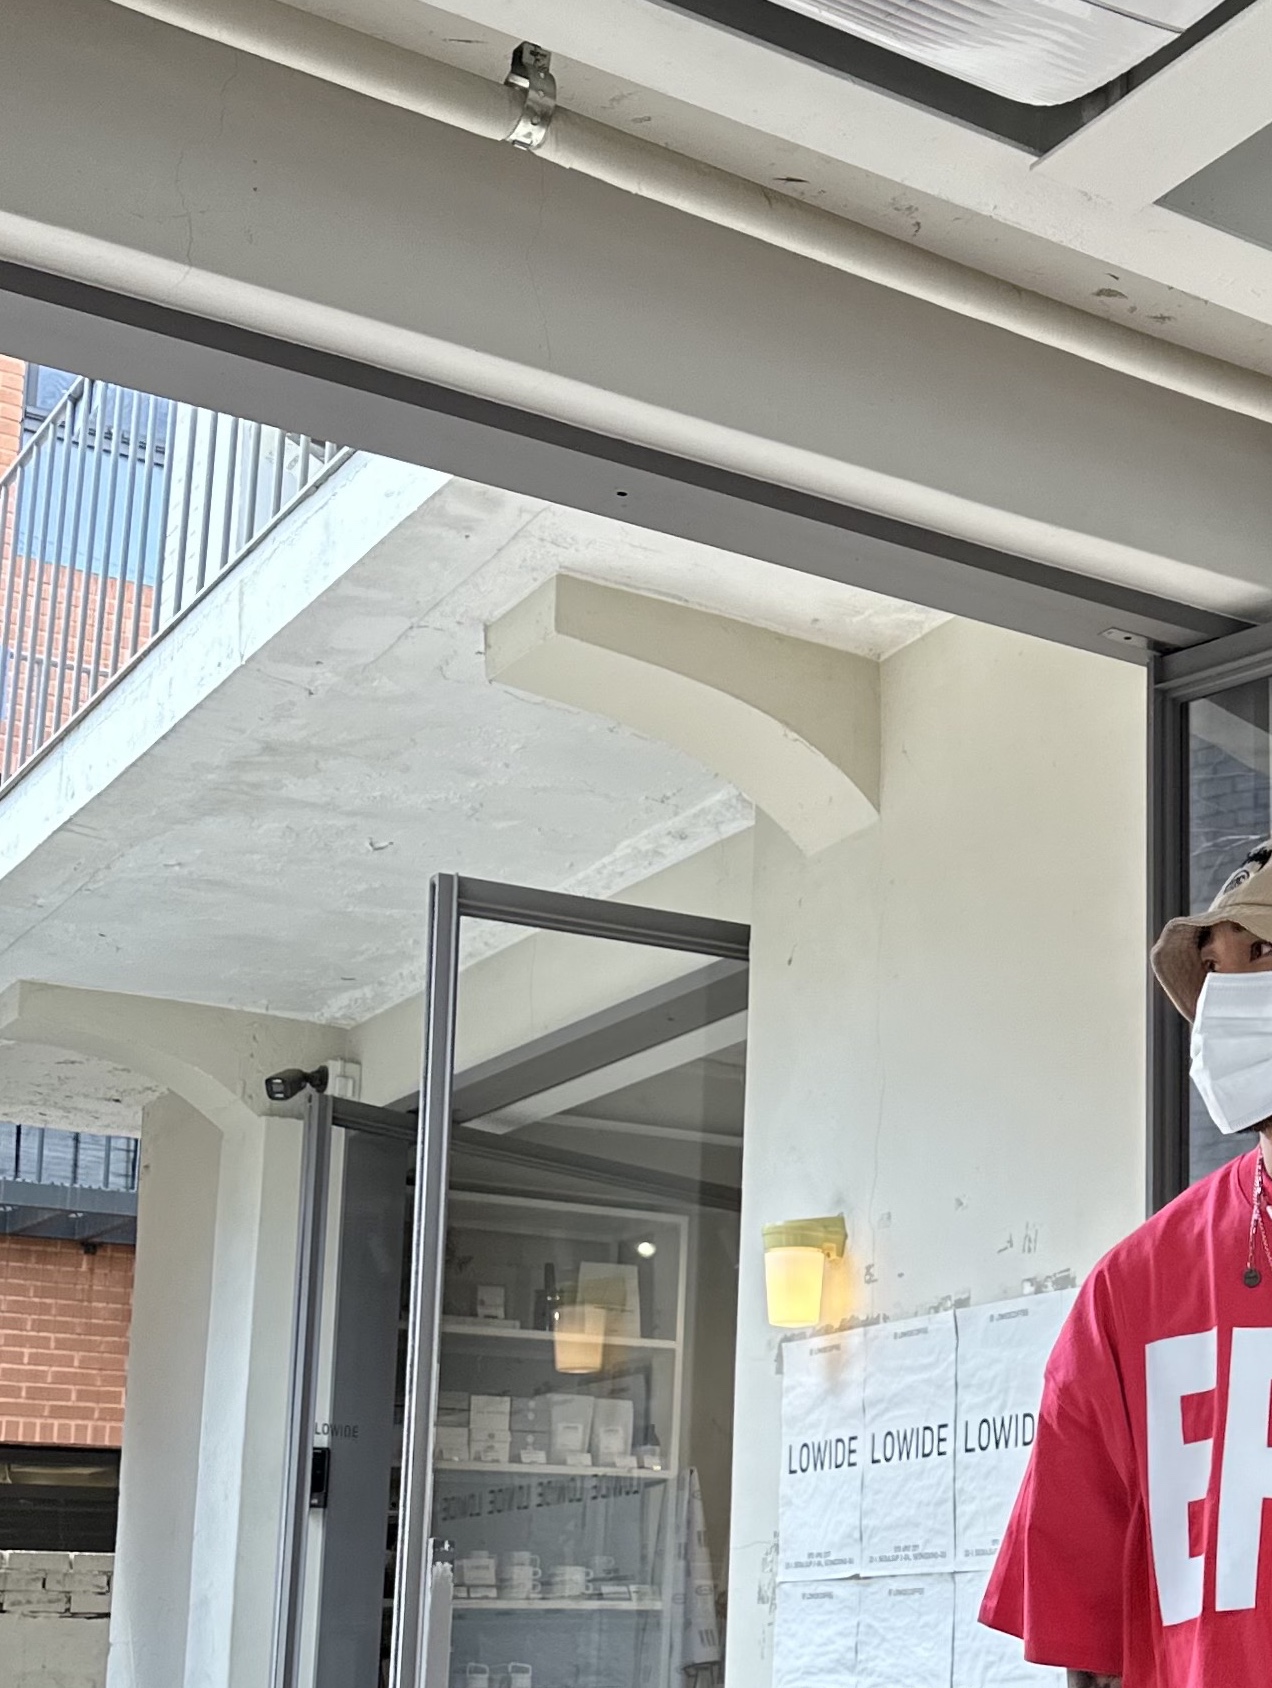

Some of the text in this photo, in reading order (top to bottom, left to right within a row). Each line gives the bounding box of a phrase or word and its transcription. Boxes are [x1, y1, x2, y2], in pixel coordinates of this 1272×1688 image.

[314, 1421, 360, 1440] LOWIDE
[870, 1422, 949, 1465] LOWIDE
[964, 1412, 1035, 1454] LOWID
[788, 1435, 859, 1475] LOWIDE
